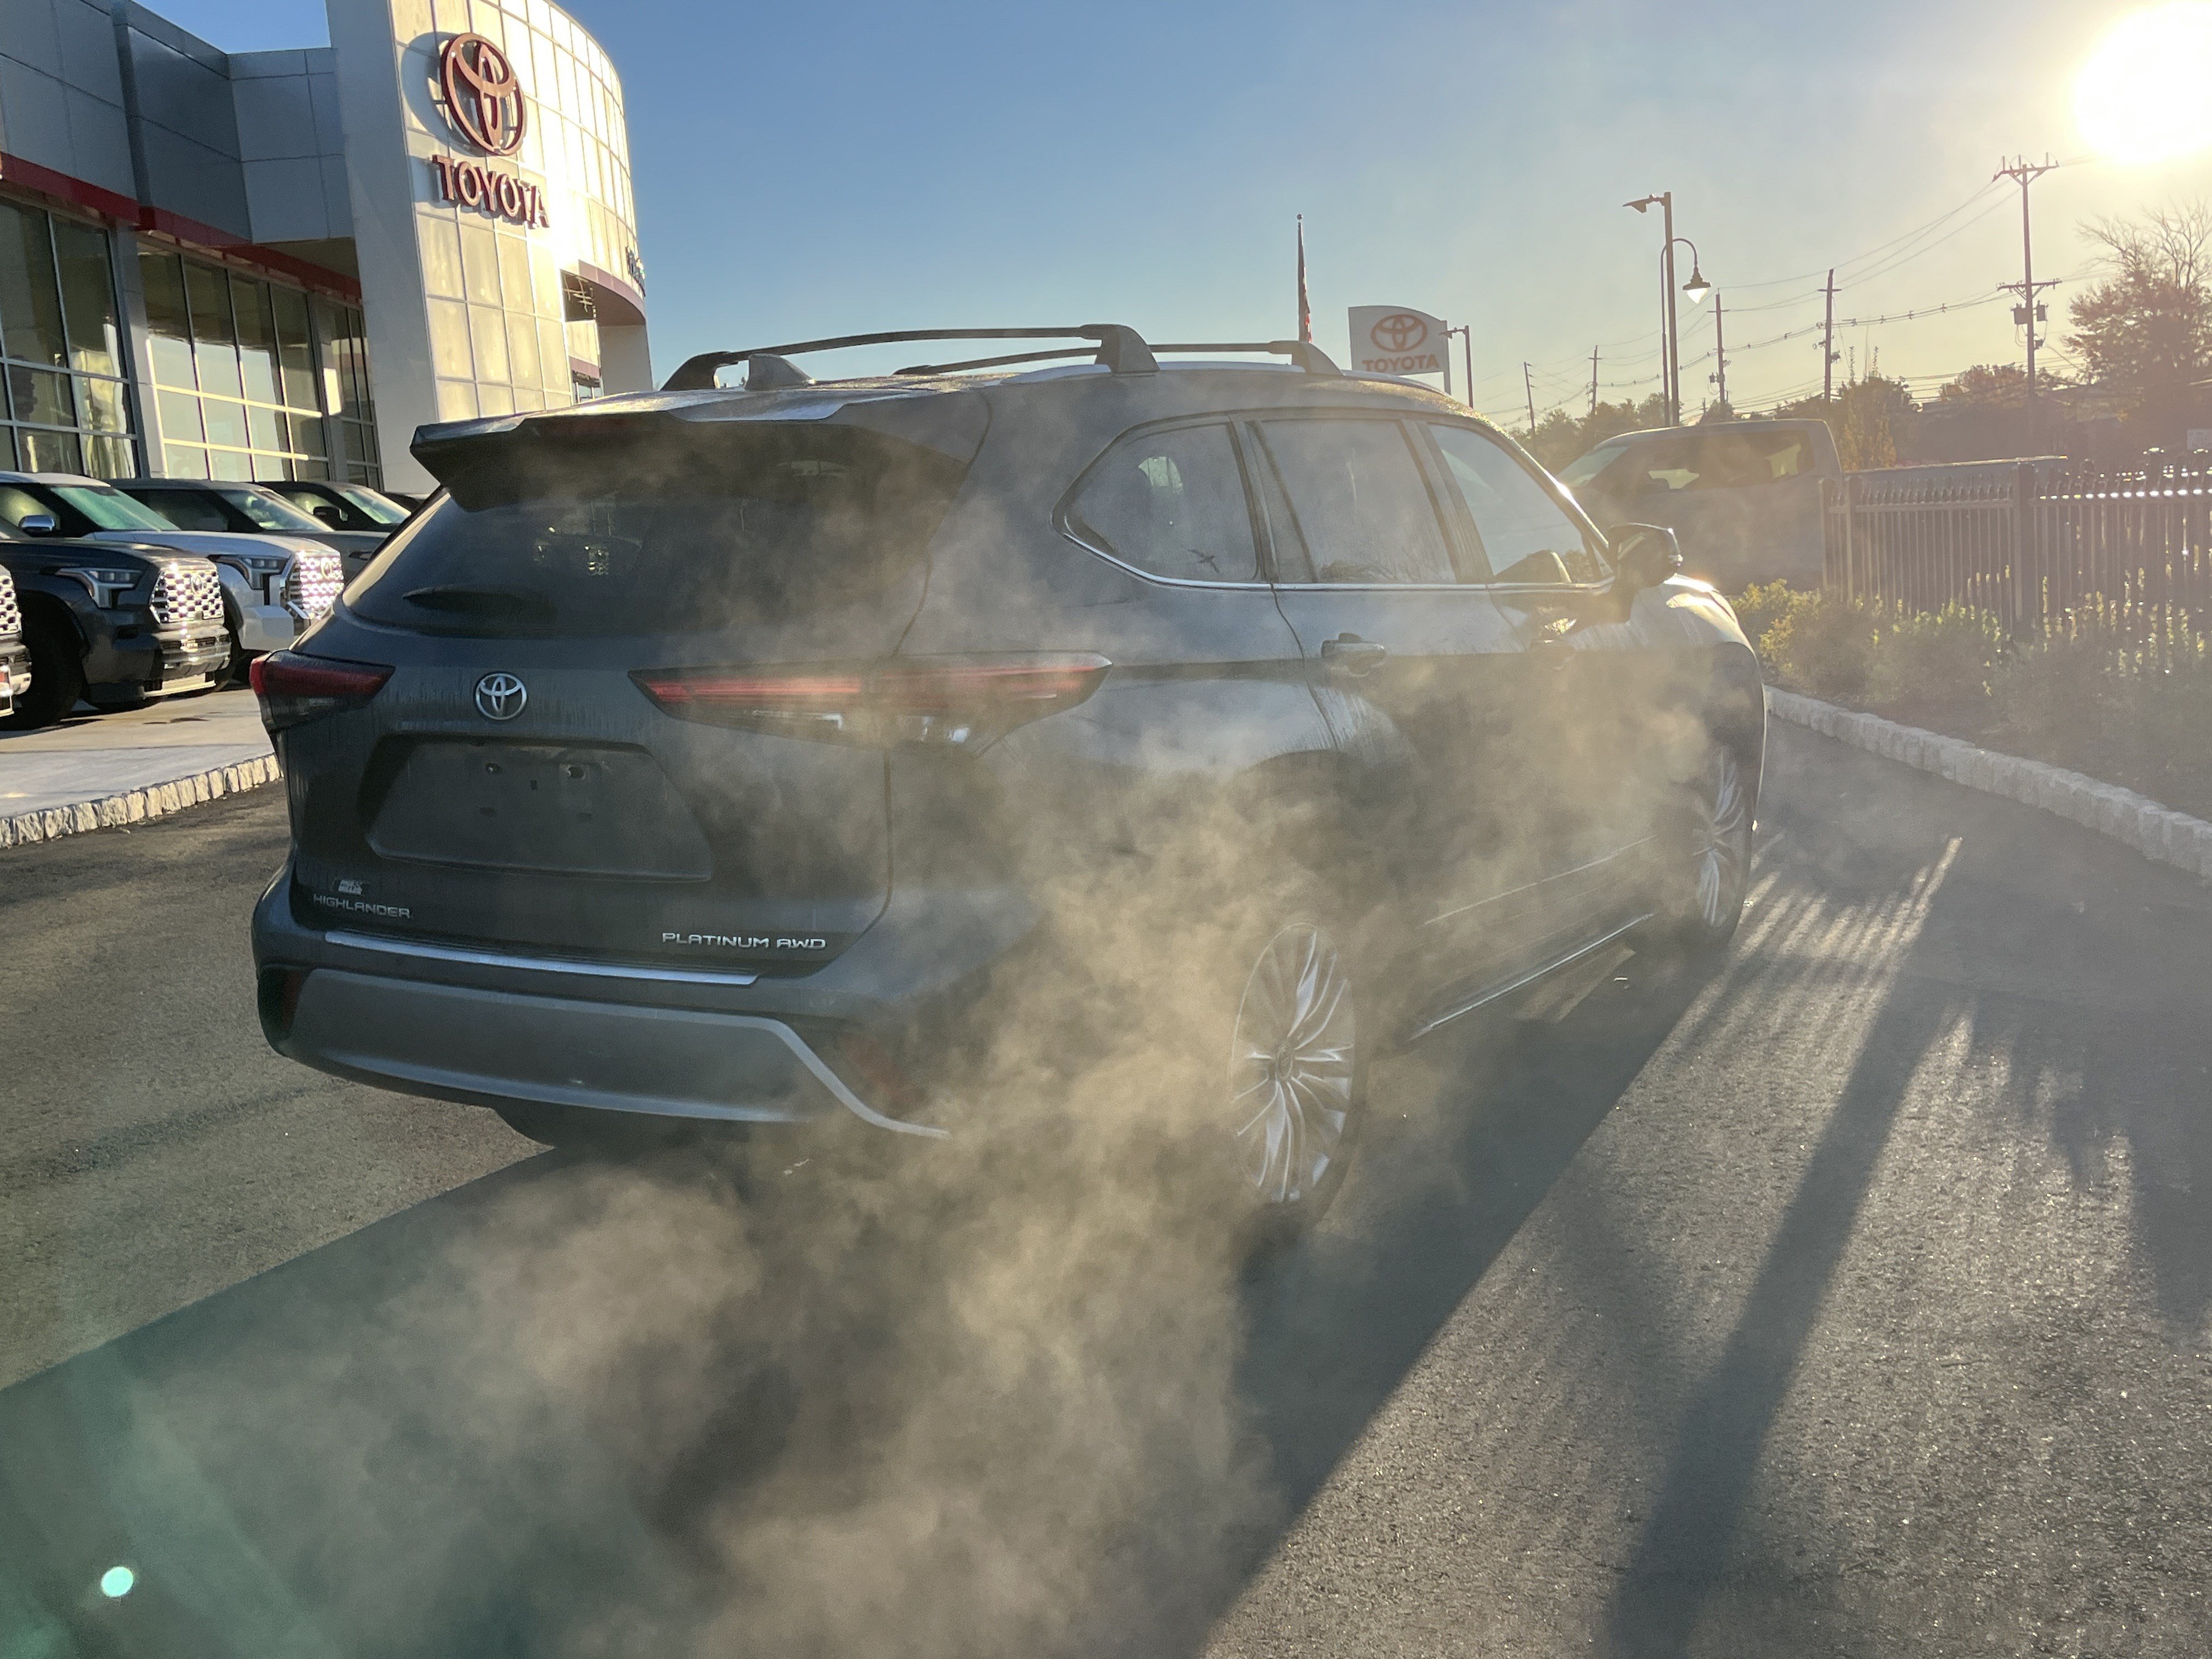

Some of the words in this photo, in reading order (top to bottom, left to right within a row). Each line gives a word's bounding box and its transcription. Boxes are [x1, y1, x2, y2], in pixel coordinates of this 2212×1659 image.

[432, 154, 550, 229] TOYOTA
[1362, 354, 1440, 373] TOYOTA
[313, 894, 411, 919] HIGHLANDER
[662, 933, 769, 948] PLATINUM
[776, 938, 826, 949] AWD
